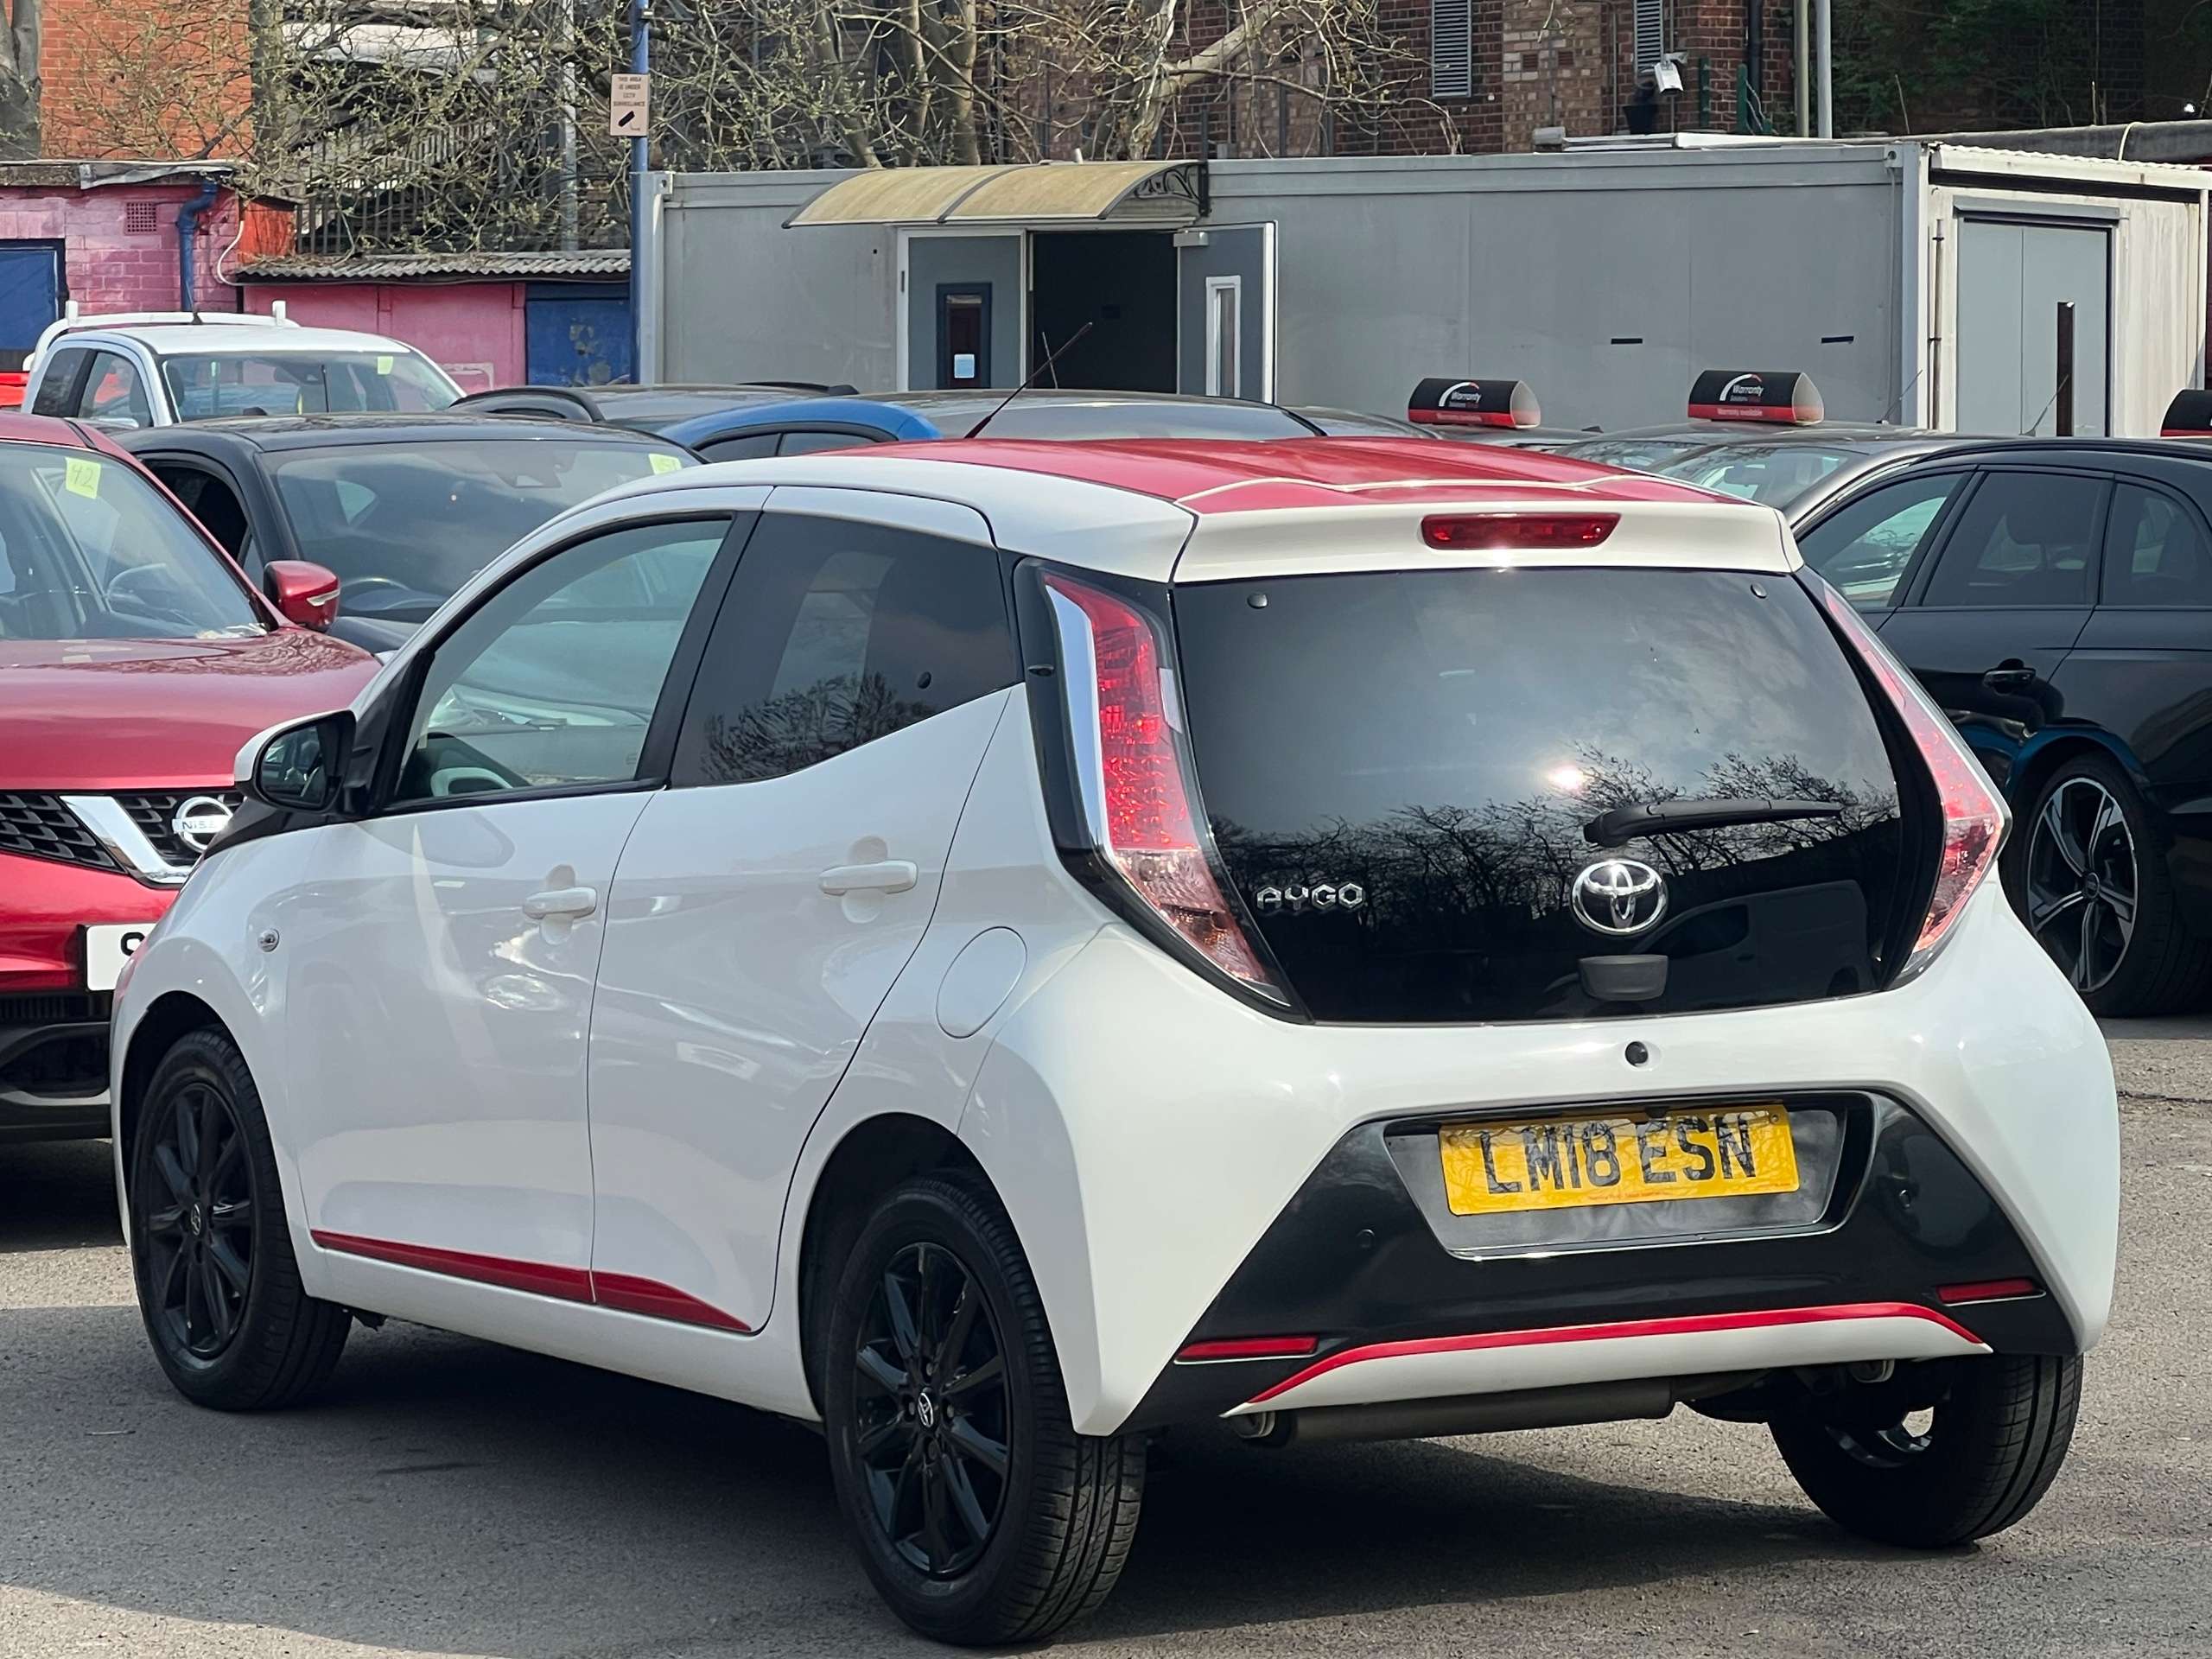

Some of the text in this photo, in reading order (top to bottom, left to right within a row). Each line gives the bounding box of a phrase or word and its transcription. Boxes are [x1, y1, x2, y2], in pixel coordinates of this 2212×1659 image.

[1452, 391, 1481, 403] Warranty
[1732, 385, 1764, 397] Warranty
[1256, 883, 1363, 911] AYGO
[1480, 1115, 1757, 1195] LM18 ESN
